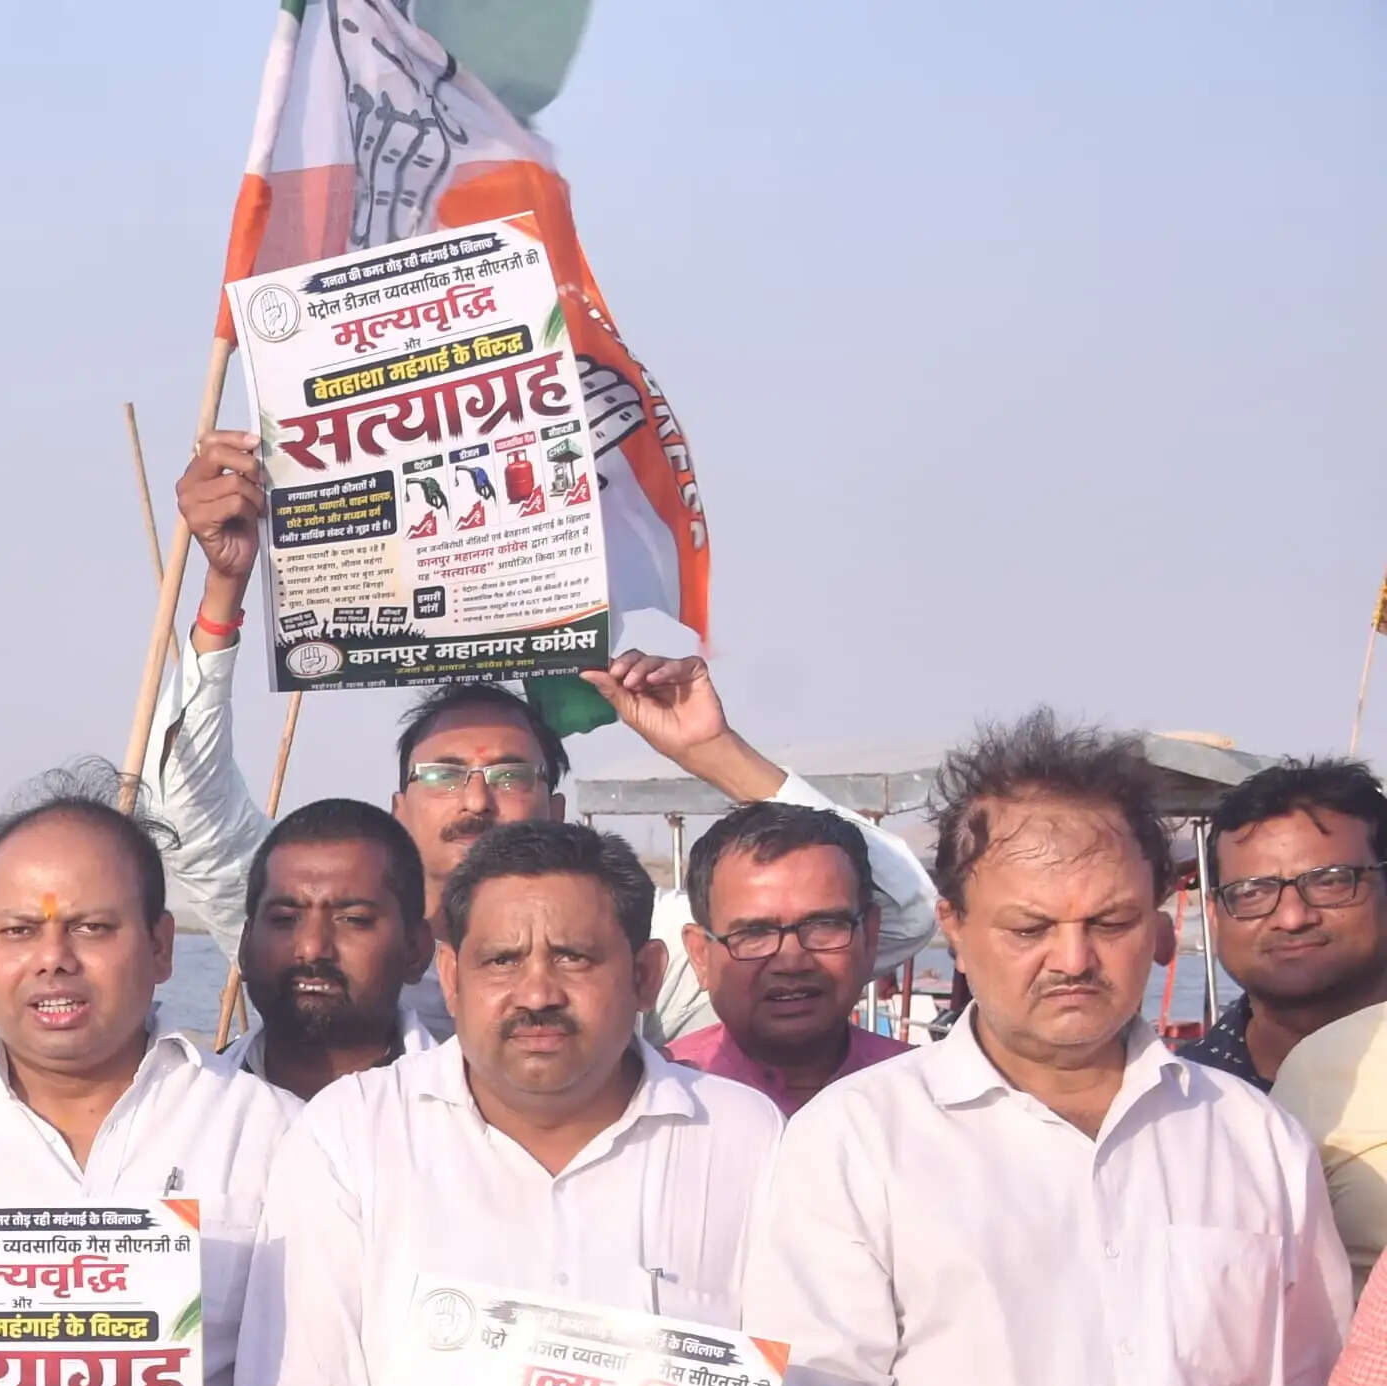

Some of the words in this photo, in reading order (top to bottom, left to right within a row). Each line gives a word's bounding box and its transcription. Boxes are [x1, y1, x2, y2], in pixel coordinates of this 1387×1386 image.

[307, 297, 341, 319] पेट्रोल
[343, 291, 381, 311] डीजल
[384, 274, 451, 302] व्यवसायिक
[453, 267, 476, 286] गैस
[478, 257, 523, 281] सीएनजी
[525, 251, 540, 268] की
[331, 283, 495, 354] मूल्यवृद्धि
[403, 338, 422, 351] और
[313, 369, 385, 402] बेतहाशा
[389, 350, 449, 380] महंगाई
[454, 345, 473, 364] के
[475, 331, 524, 360] विरुद्ध
[277, 352, 572, 470] सत्याग्रह
[347, 644, 429, 669] कानपुर
[433, 640, 527, 661] महानगर
[531, 630, 598, 654] कांग्रेस
[11, 1211, 31, 1228] तोड़
[32, 1211, 51, 1226] रही
[52, 1211, 87, 1227] महंगाई
[88, 1211, 100, 1225] के
[102, 1211, 142, 1225] खिलाफ
[3, 1235, 82, 1253] व्यवसायिक
[86, 1235, 111, 1253] गैस
[114, 1234, 171, 1253] सीएनजी
[174, 1235, 190, 1252] की
[12, 1296, 32, 1309] और
[64, 1313, 86, 1336] के
[89, 1313, 149, 1339] विरुद्ध
